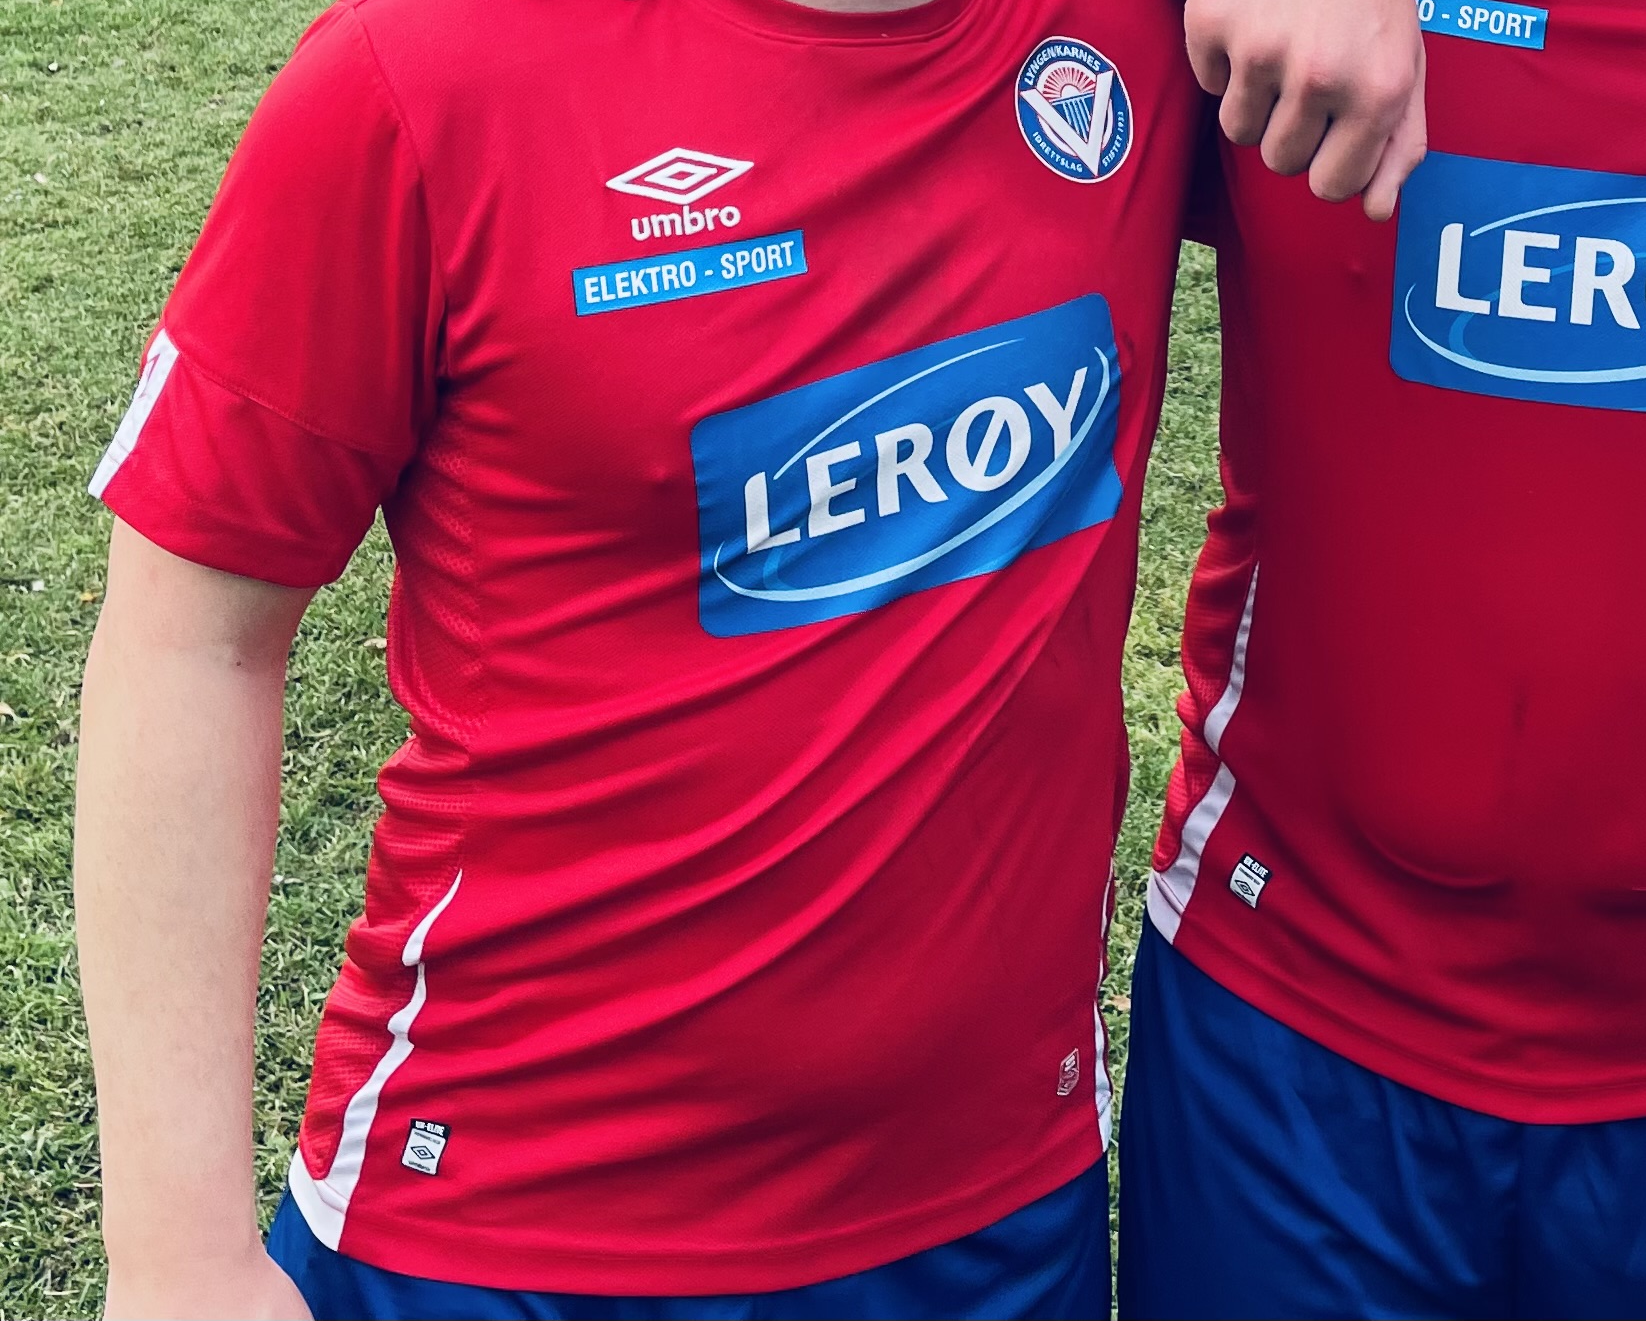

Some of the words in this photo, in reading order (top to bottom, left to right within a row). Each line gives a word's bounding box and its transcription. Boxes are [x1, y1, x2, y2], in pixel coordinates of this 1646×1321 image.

[1457, 5, 1537, 39] SPORT
[1024, 44, 1102, 86] LYNGEN/KARNES
[1032, 131, 1083, 173] IDRETTSLAG
[630, 205, 741, 241] umbro
[584, 260, 697, 304] ELEKTRO
[720, 240, 794, 280] SPORT
[744, 366, 1089, 555] LERØY
